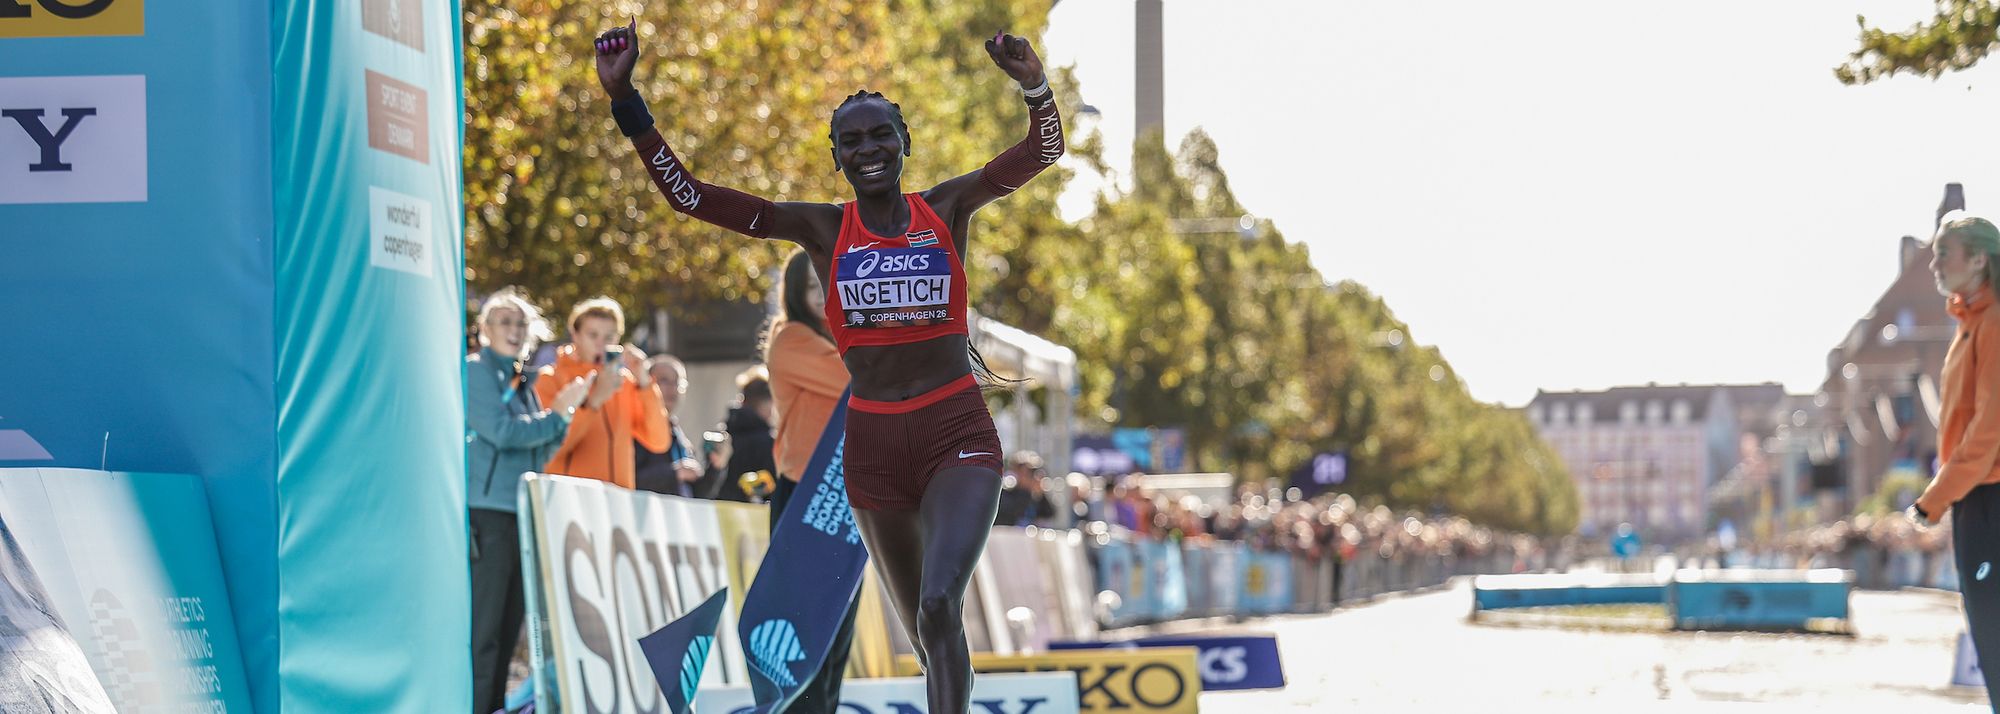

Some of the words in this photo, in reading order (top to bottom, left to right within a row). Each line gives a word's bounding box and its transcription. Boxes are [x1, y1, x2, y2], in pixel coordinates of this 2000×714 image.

[1040, 110, 1061, 164] KENYA
[652, 145, 701, 211] KENYA
[843, 278, 944, 306] NGETICH
[870, 310, 936, 323] COPENHAGEN
[937, 309, 947, 319] 26
[801, 482, 829, 525] WORLD
[812, 489, 840, 532] ROAD
